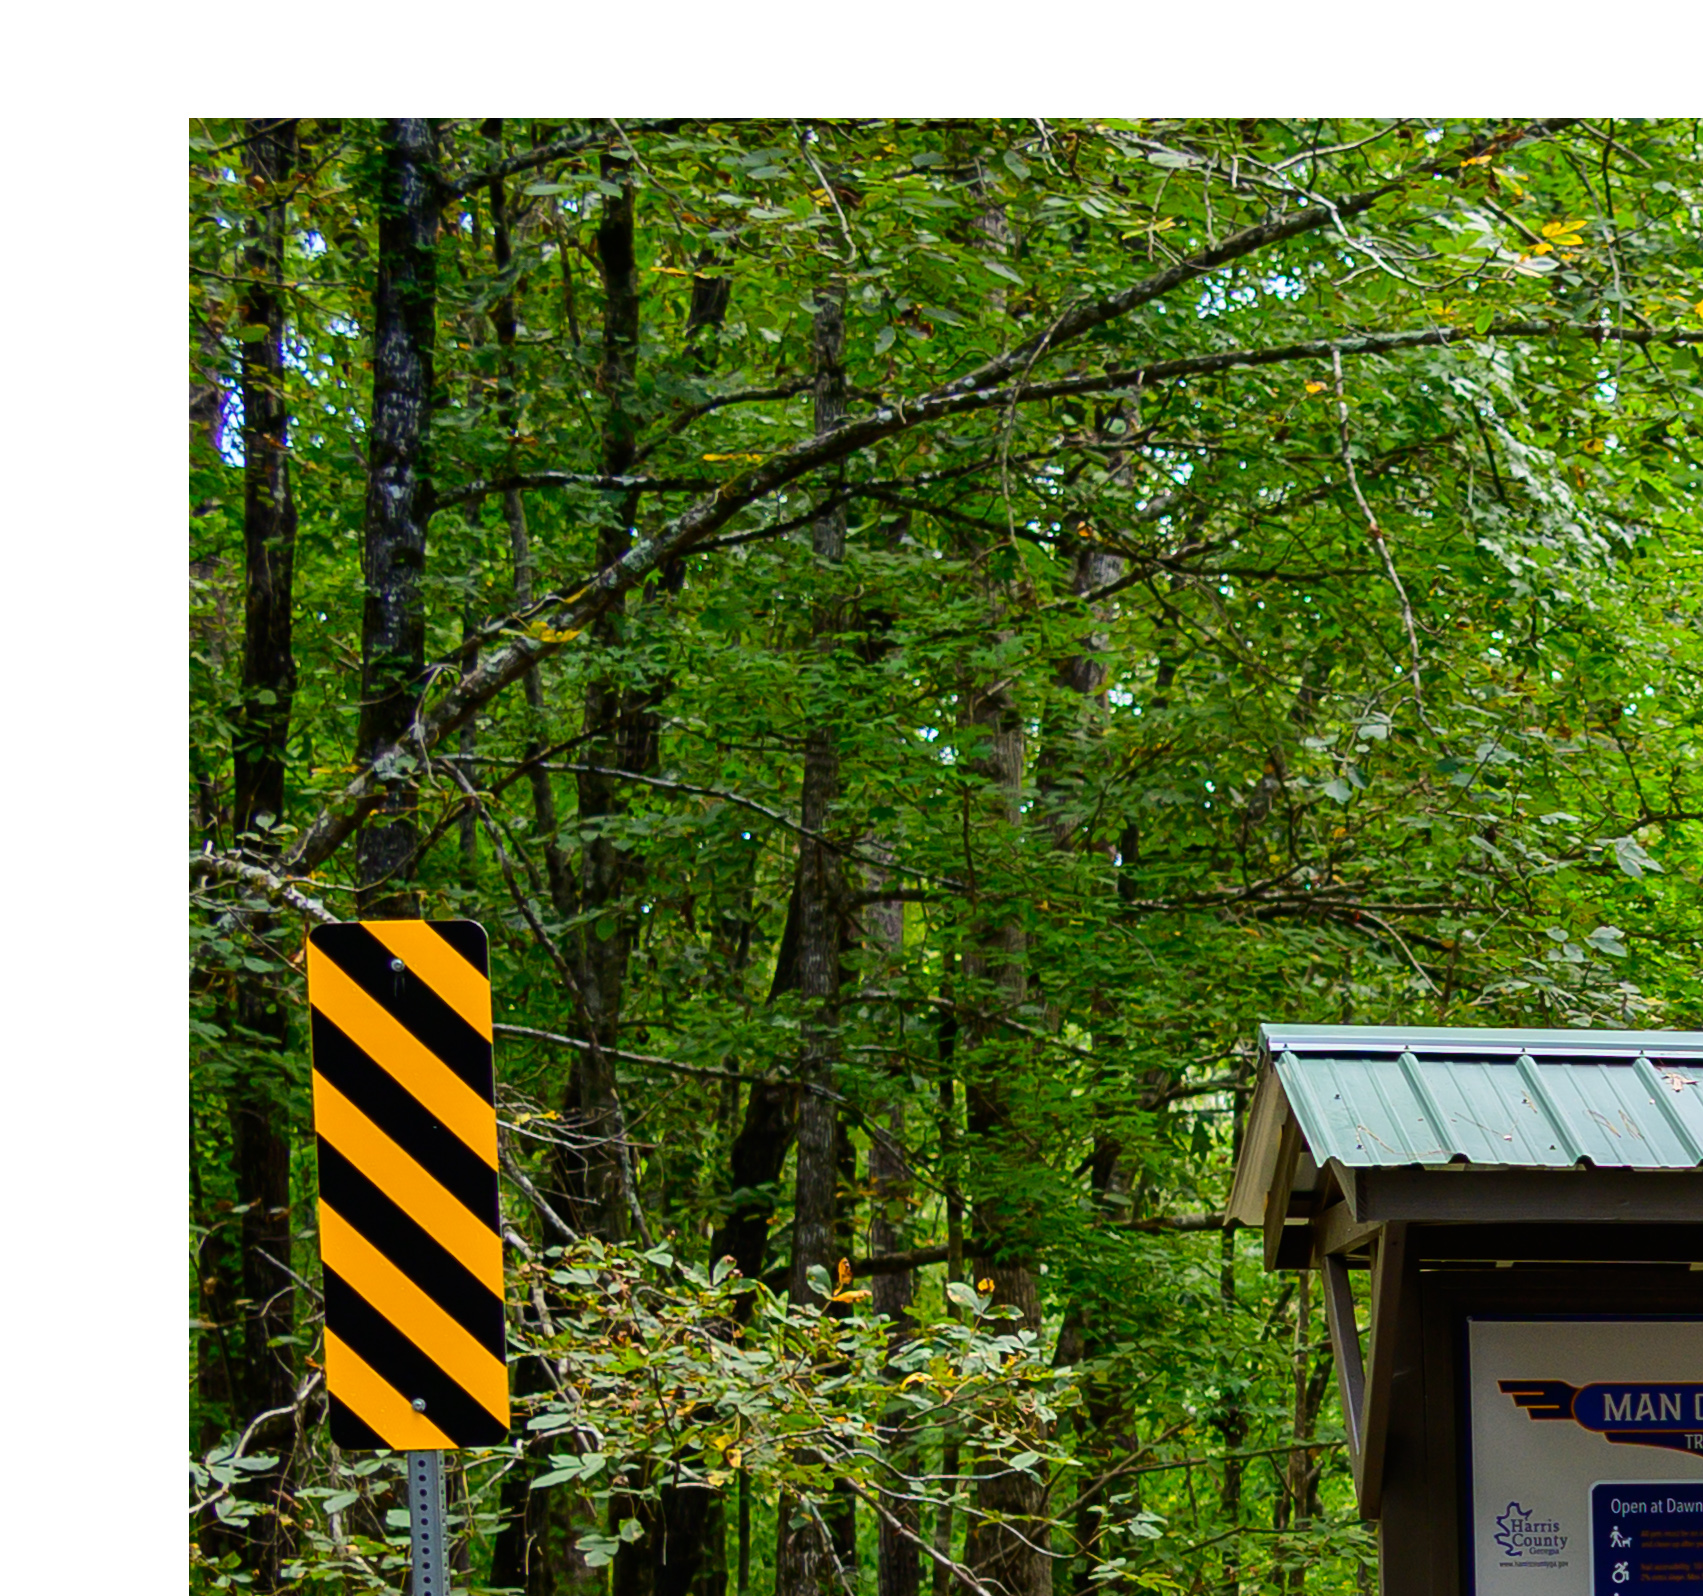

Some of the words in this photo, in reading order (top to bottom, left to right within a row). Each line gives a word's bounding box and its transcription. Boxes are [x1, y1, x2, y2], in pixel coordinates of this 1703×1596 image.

[1603, 1392, 1681, 1421] MAN
[1611, 1498, 1647, 1517] Open
[1651, 1500, 1663, 1513] at
[1667, 1497, 1703, 1512] Dawn
[1511, 1518, 1560, 1532] Harris
[1512, 1533, 1567, 1549] County
